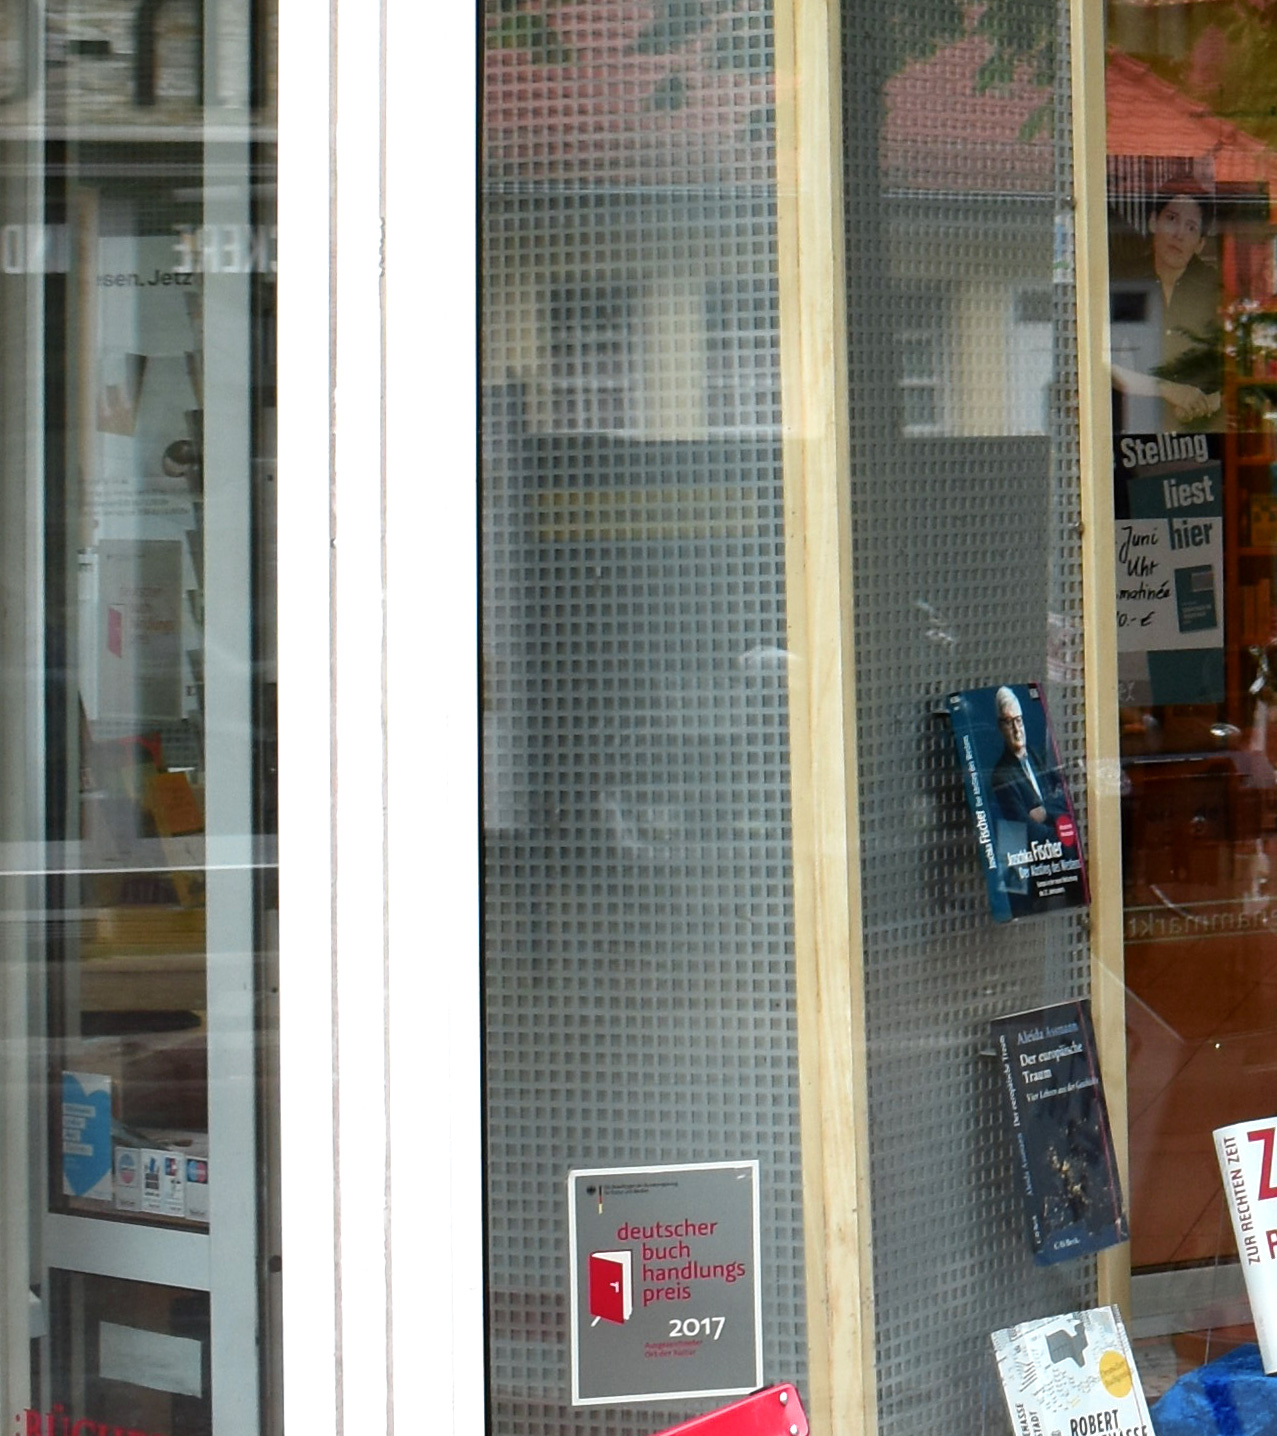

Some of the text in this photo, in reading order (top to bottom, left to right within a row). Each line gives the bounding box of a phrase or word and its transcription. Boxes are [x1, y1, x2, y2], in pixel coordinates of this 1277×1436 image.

[1120, 431, 1209, 468] Stelling
[1163, 475, 1214, 509] liest
[1119, 526, 1159, 563] Juni
[1167, 517, 1213, 551] hier
[1031, 839, 1063, 861] Fischer
[1019, 1053, 1037, 1067] Der
[1223, 1136, 1260, 1265] ZUR RECHTEN ZEIT
[617, 1219, 718, 1241] deutscher
[642, 1241, 690, 1261] buch
[642, 1261, 746, 1283] handlungs
[643, 1282, 691, 1307] preis
[669, 1316, 726, 1340] 2017
